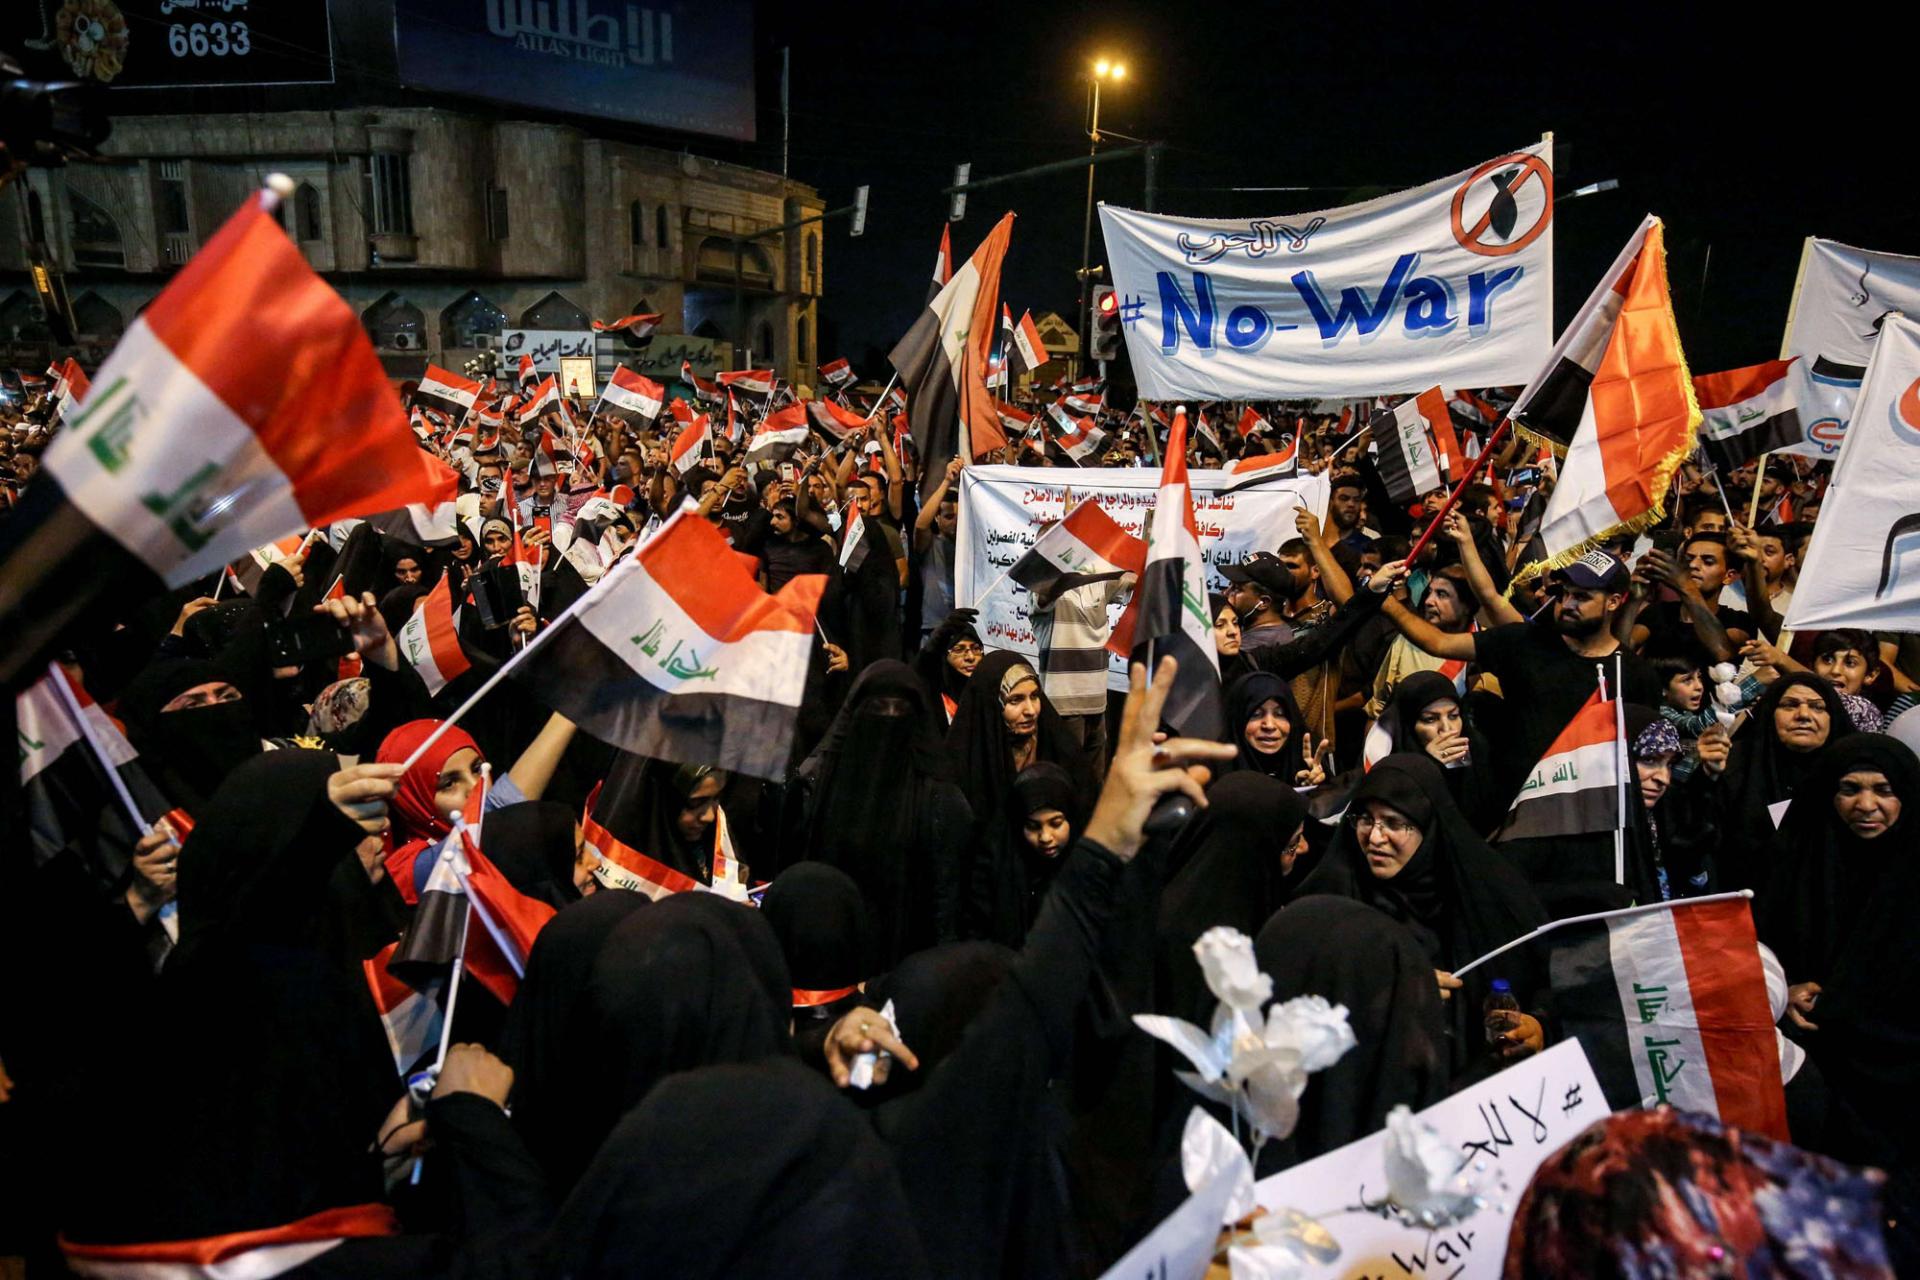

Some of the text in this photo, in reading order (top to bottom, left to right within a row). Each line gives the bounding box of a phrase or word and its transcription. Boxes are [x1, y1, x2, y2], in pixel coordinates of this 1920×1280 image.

[169, 21, 251, 57] 6633
[514, 32, 626, 68] ATLAS LIGHT
[1177, 217, 1326, 264] لا للحرب
[1023, 488, 1054, 506] الاصلاح
[1391, 1229, 1475, 1275] War
